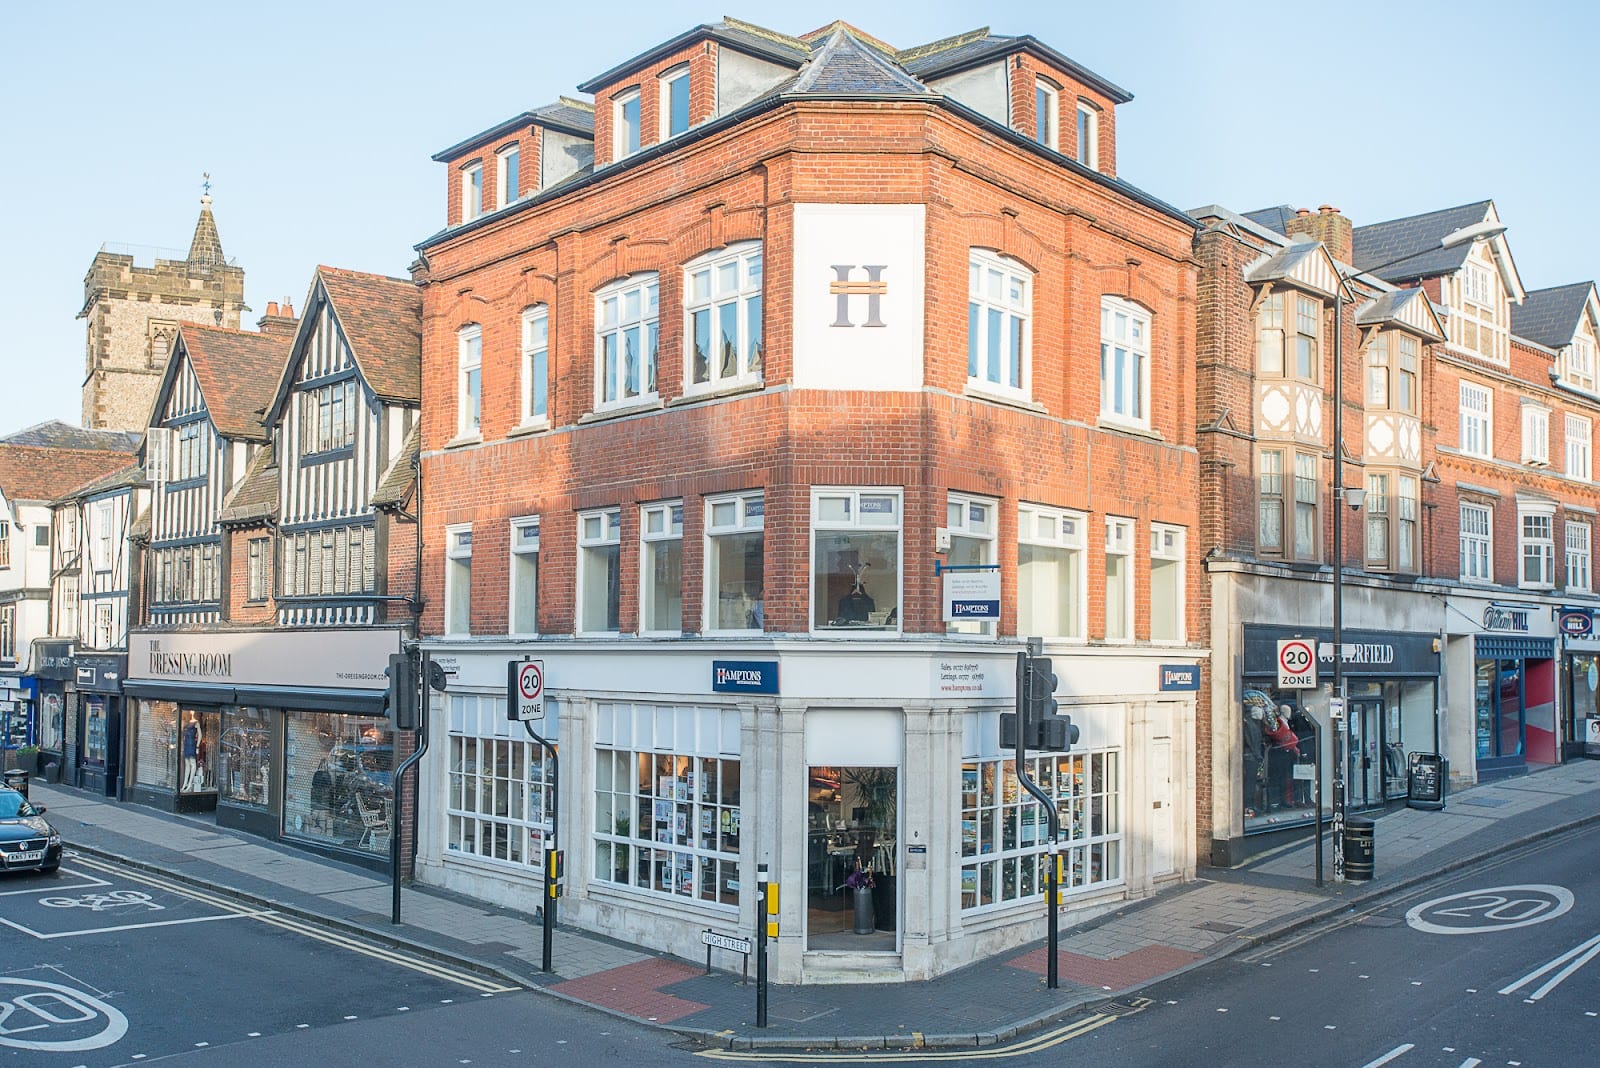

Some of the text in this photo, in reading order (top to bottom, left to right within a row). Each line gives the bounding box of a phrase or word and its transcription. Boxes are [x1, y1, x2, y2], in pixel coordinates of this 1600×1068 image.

[829, 264, 888, 328] H
[955, 604, 989, 613] HAMPTONS
[1512, 611, 1528, 631] HILL
[1567, 622, 1583, 630] HILL
[149, 640, 161, 652] THE
[149, 652, 232, 677] DRESSING ROOM
[1286, 651, 1309, 665] 20
[523, 674, 539, 689] 20
[716, 667, 761, 684] HAMPTONS
[1164, 670, 1193, 685] HAMPTONS
[1282, 676, 1312, 685] ZONE
[522, 704, 541, 714] ZONE
[1432, 895, 1552, 920] 20
[704, 934, 748, 951] HIGH STREET
